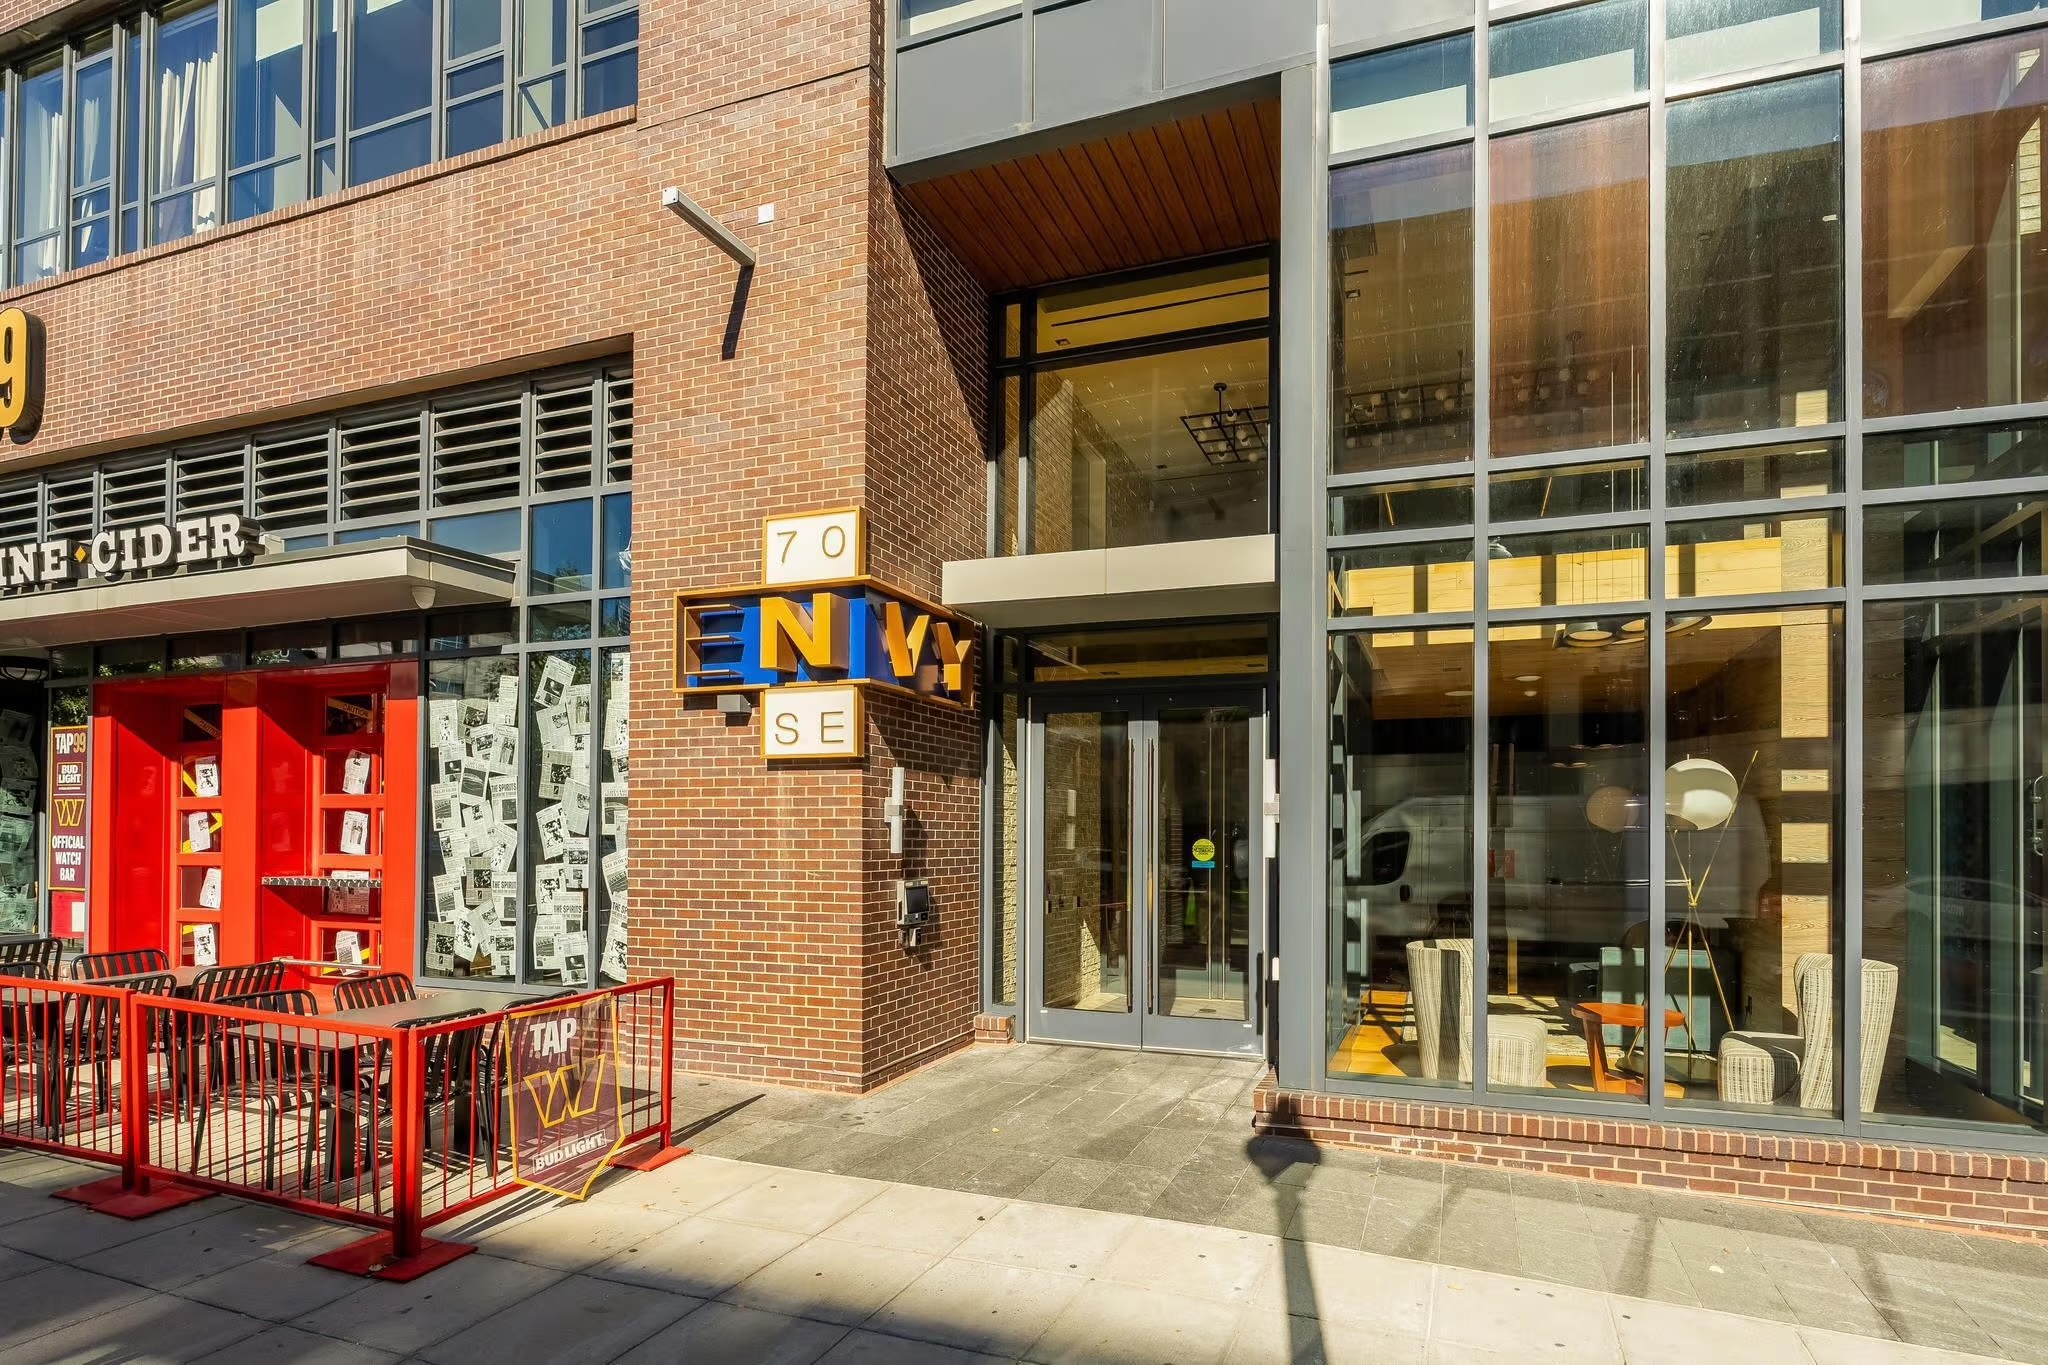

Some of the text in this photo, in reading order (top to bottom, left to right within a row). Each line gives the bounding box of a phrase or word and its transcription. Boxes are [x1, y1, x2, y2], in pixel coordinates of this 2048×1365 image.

[91, 513, 246, 573] CIDER
[776, 525, 846, 564] 70
[774, 711, 845, 745] SE
[58, 774, 82, 784] LIGHT
[61, 764, 79, 774] BUD
[52, 835, 85, 849] OFFICIAL
[55, 851, 82, 865] WATCH
[59, 867, 75, 882] BAR
[530, 1017, 577, 1057] TAP
[535, 1133, 603, 1172] BUD LIGHT
